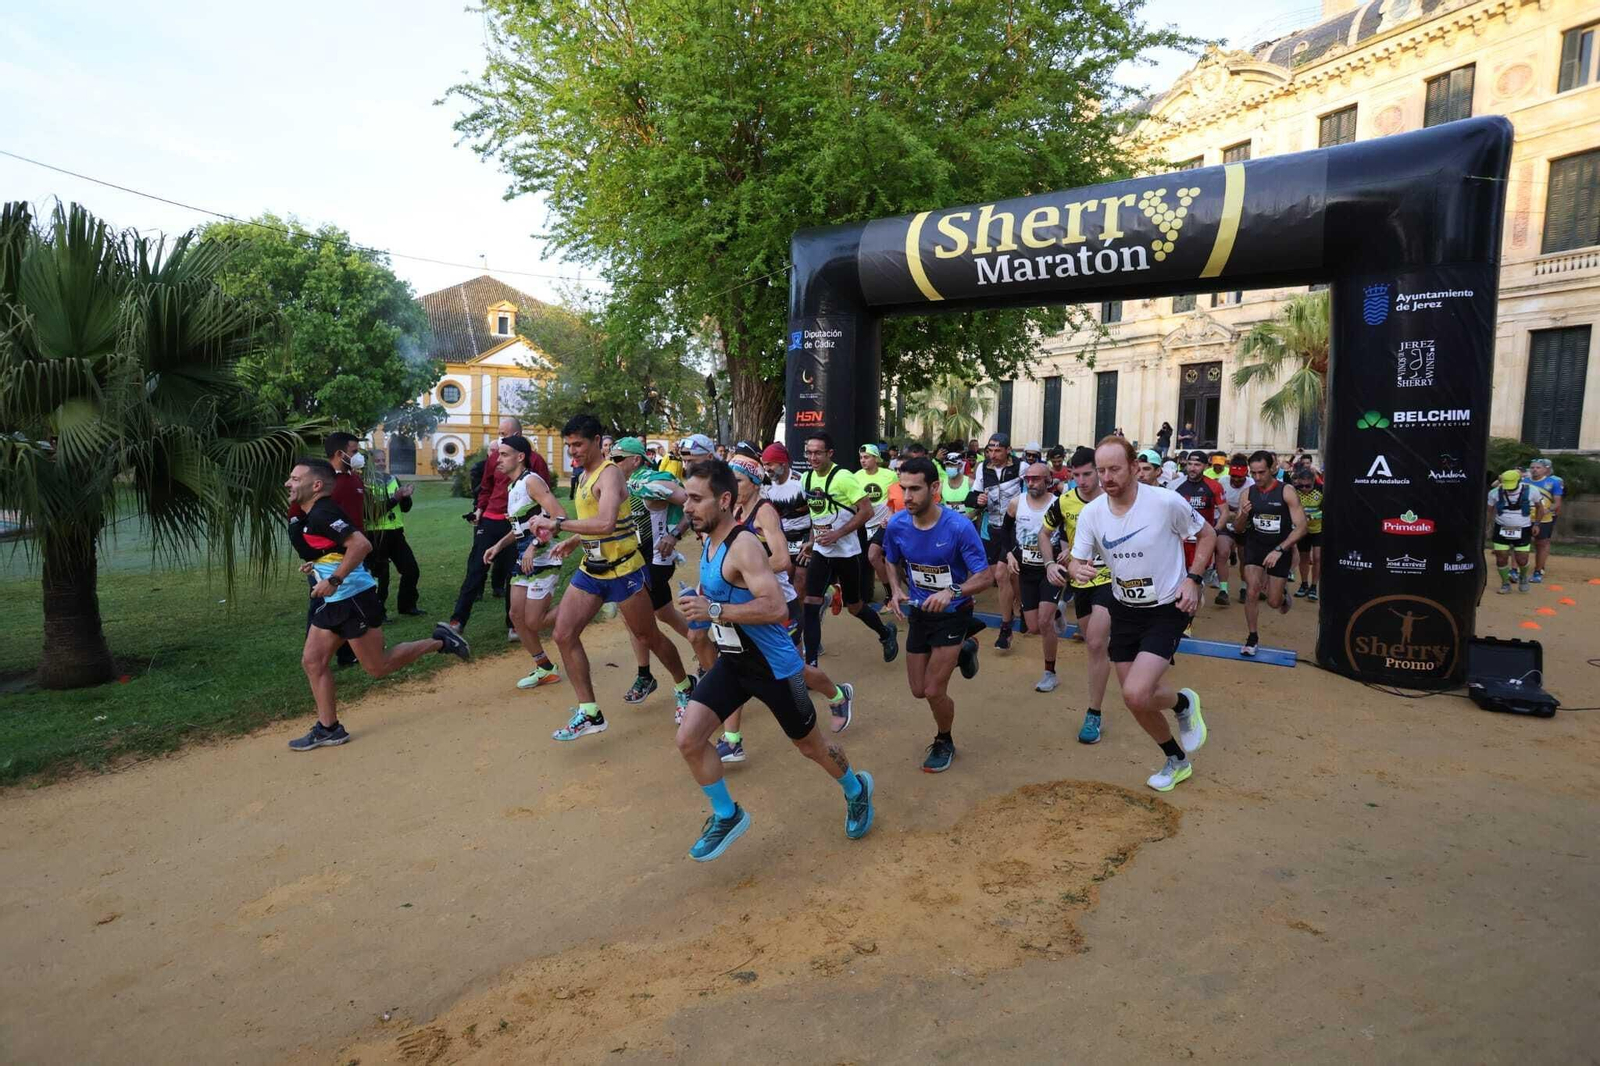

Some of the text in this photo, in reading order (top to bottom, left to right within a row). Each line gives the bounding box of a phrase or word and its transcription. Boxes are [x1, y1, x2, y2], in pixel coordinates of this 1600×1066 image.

[973, 238, 1151, 286] Maratón
[1396, 289, 1474, 304] Ayuntamiento
[1396, 300, 1443, 311] de Jerez
[804, 330, 842, 339] Diputación
[804, 340, 836, 349] de Cádiz
[1400, 340, 1435, 352] JEREZ
[1425, 352, 1436, 379] WINES
[1397, 378, 1434, 388] SHERRY
[1393, 409, 1471, 423] BELCHIM
[1379, 477, 1410, 485] Andalucía
[1259, 520, 1272, 528] 53
[1383, 522, 1432, 532] Primeale
[1339, 558, 1373, 569] COVIJEREZ
[923, 573, 937, 584] 51
[1120, 587, 1147, 599] 102
[715, 624, 722, 639] 1
[1355, 636, 1450, 668] Sherry
[1385, 657, 1435, 671] Promo
